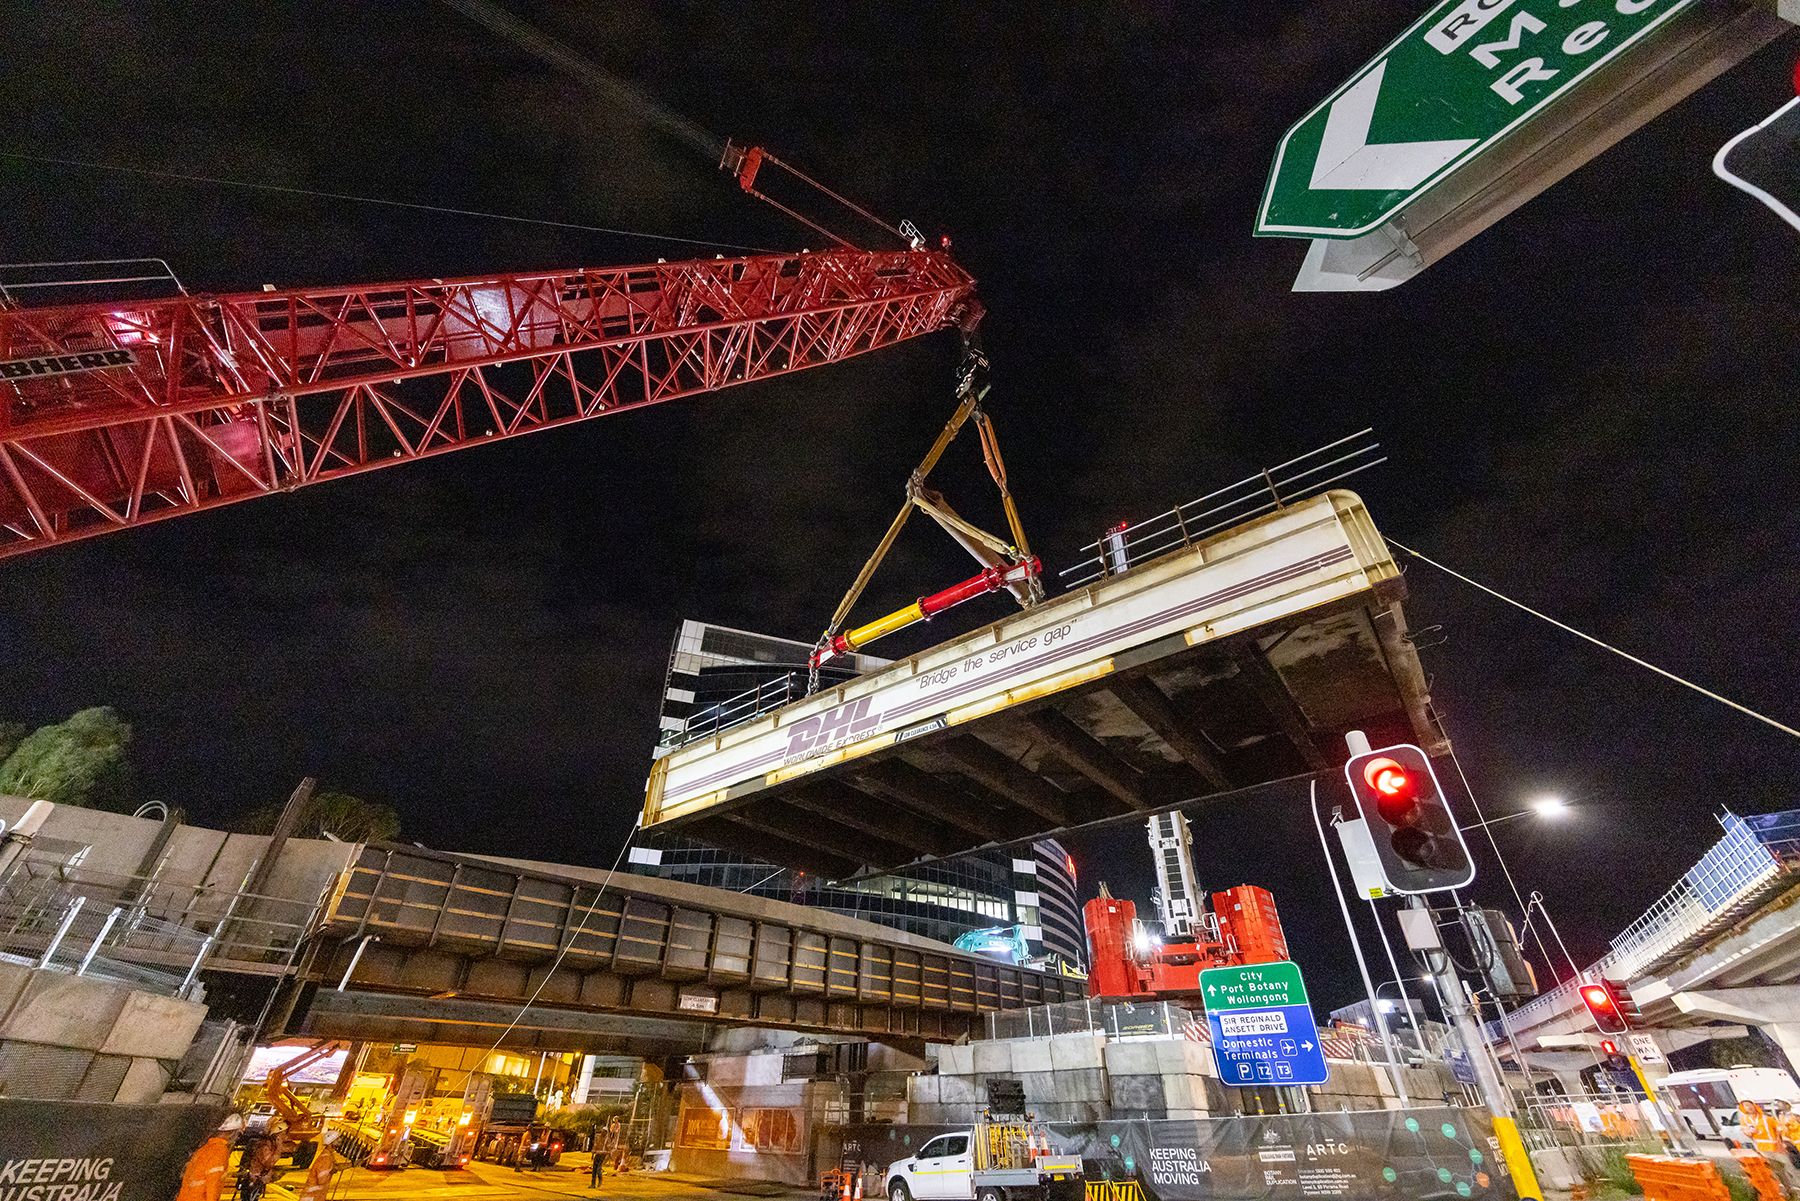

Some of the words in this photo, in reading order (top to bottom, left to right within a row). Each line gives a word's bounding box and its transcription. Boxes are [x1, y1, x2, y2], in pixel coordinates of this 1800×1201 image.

[1468, 0, 1582, 69] M
[963, 656, 983, 673] the
[988, 637, 1037, 664] service
[786, 695, 882, 757] DHL
[784, 744, 833, 766] WORLDWIDE
[1240, 972, 1263, 982] City
[1220, 984, 1244, 994] Port
[1249, 981, 1289, 991] Botany
[1227, 993, 1289, 1005] Wollongong
[1223, 1016, 1237, 1025] SIR
[1240, 1014, 1282, 1024] REGINALD
[1225, 1025, 1255, 1034] ANSETT
[1259, 1023, 1285, 1032] DRIVE
[1222, 1038, 1274, 1049] Domestic
[1632, 1037, 1652, 1045] ONE
[1224, 1050, 1278, 1061] Terminals
[1636, 1046, 1656, 1054] WAY
[1258, 1066, 1271, 1076] T2
[1277, 1065, 1291, 1075] T3
[1149, 1148, 1197, 1160] KEEPING
[1307, 1141, 1349, 1157] ARTC
[0, 1157, 115, 1184] KEEPING
[1152, 1160, 1212, 1173] AUSTRALIA
[1153, 1172, 1199, 1185] MOVING
